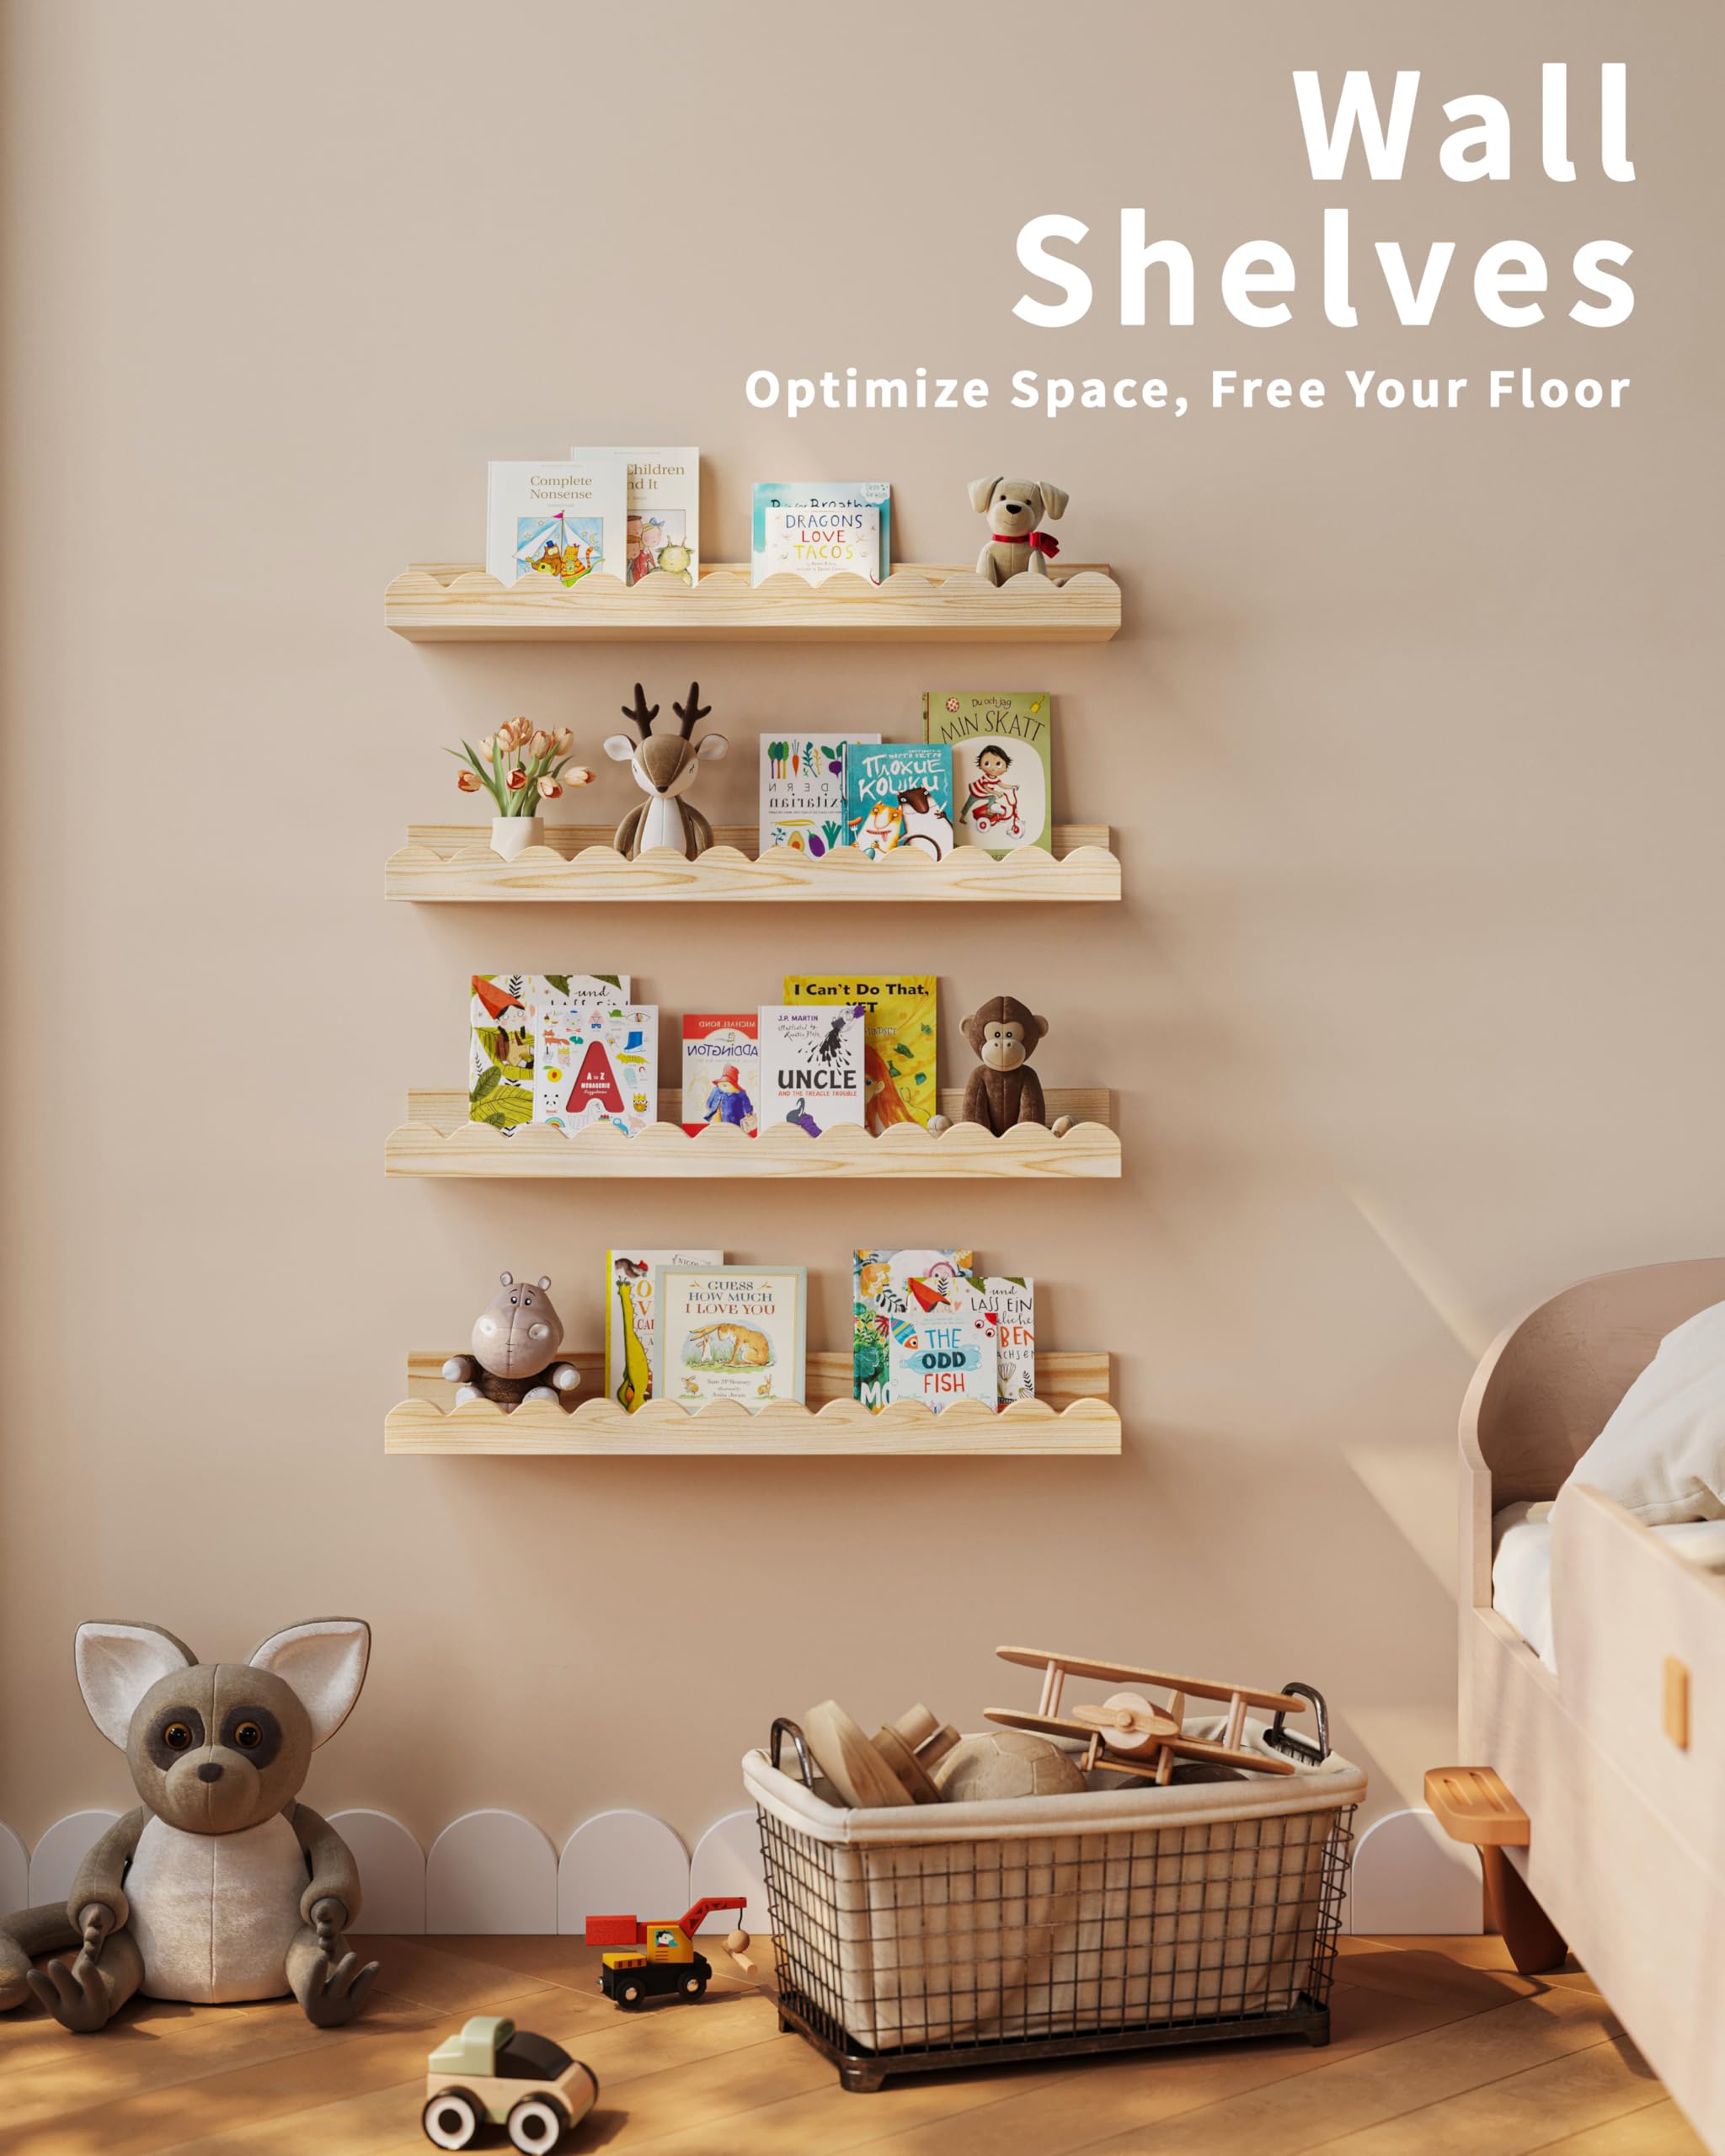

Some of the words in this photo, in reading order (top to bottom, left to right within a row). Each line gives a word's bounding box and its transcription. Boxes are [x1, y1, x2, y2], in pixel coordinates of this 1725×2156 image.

[530, 476, 593, 488] Complete
[648, 478, 659, 490] It
[530, 488, 593, 499] Nonsense
[786, 515, 862, 529] DRAGONS
[802, 530, 846, 543] LOVE
[793, 545, 854, 560] TACOS
[972, 699, 983, 707] Du
[984, 696, 997, 705] och
[996, 698, 1012, 709] jag
[940, 713, 979, 744] MIN
[985, 710, 1045, 741] SKATT
[574, 985, 611, 998] und
[794, 984, 800, 995] I
[806, 984, 851, 995] Can't
[857, 984, 880, 995] Do
[886, 984, 929, 996] That,
[777, 1070, 857, 1090] UNCLE
[708, 1281, 754, 1291] GUESS
[991, 1286, 1017, 1295] und
[688, 1292, 724, 1302] HOW
[728, 1292, 772, 1302] MUCH
[686, 1303, 690, 1315] I
[697, 1304, 739, 1315] LOVE
[743, 1305, 776, 1315] YOU
[924, 1328, 963, 1348] THE
[921, 1352, 966, 1369] ODD
[924, 1373, 965, 1394] FISH
